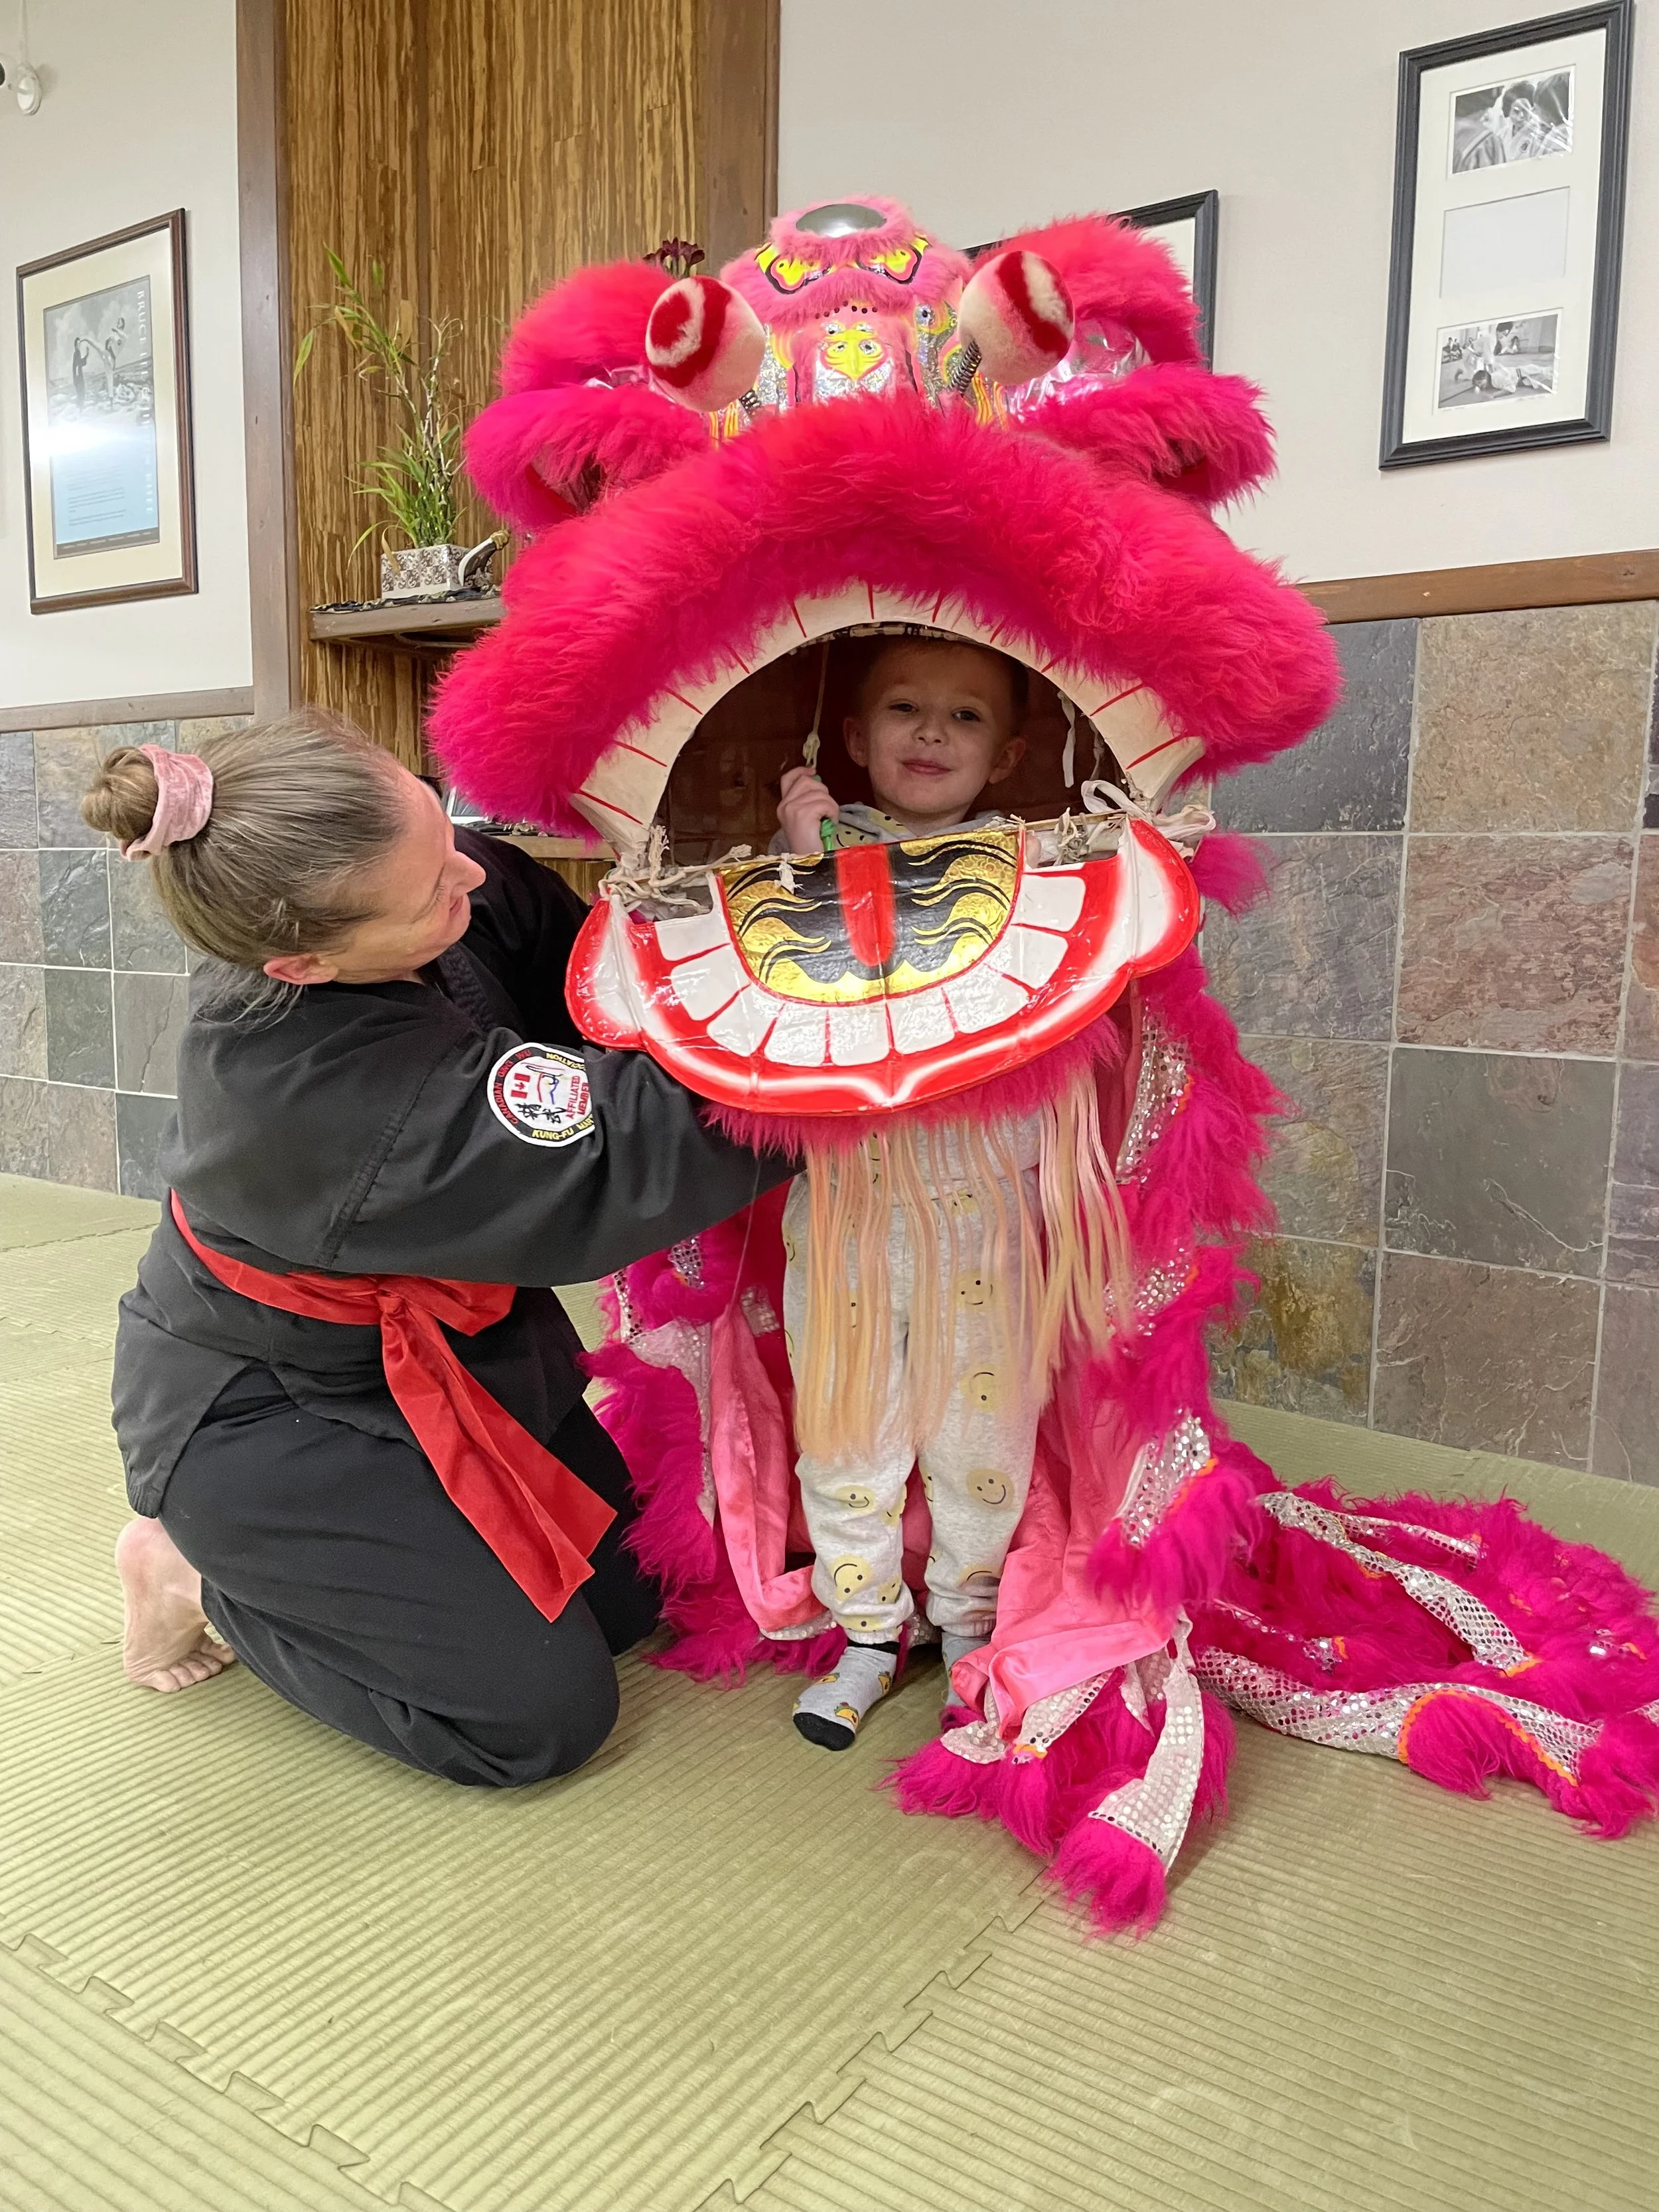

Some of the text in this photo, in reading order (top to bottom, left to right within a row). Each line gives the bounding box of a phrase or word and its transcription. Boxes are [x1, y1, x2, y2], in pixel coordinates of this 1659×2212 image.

[494, 1082, 518, 1124] CANADIAN
[566, 1075, 580, 1119] AFFILIATED
[578, 1082, 589, 1115] MEMBER
[532, 1128, 575, 1140] KUNG-FU
